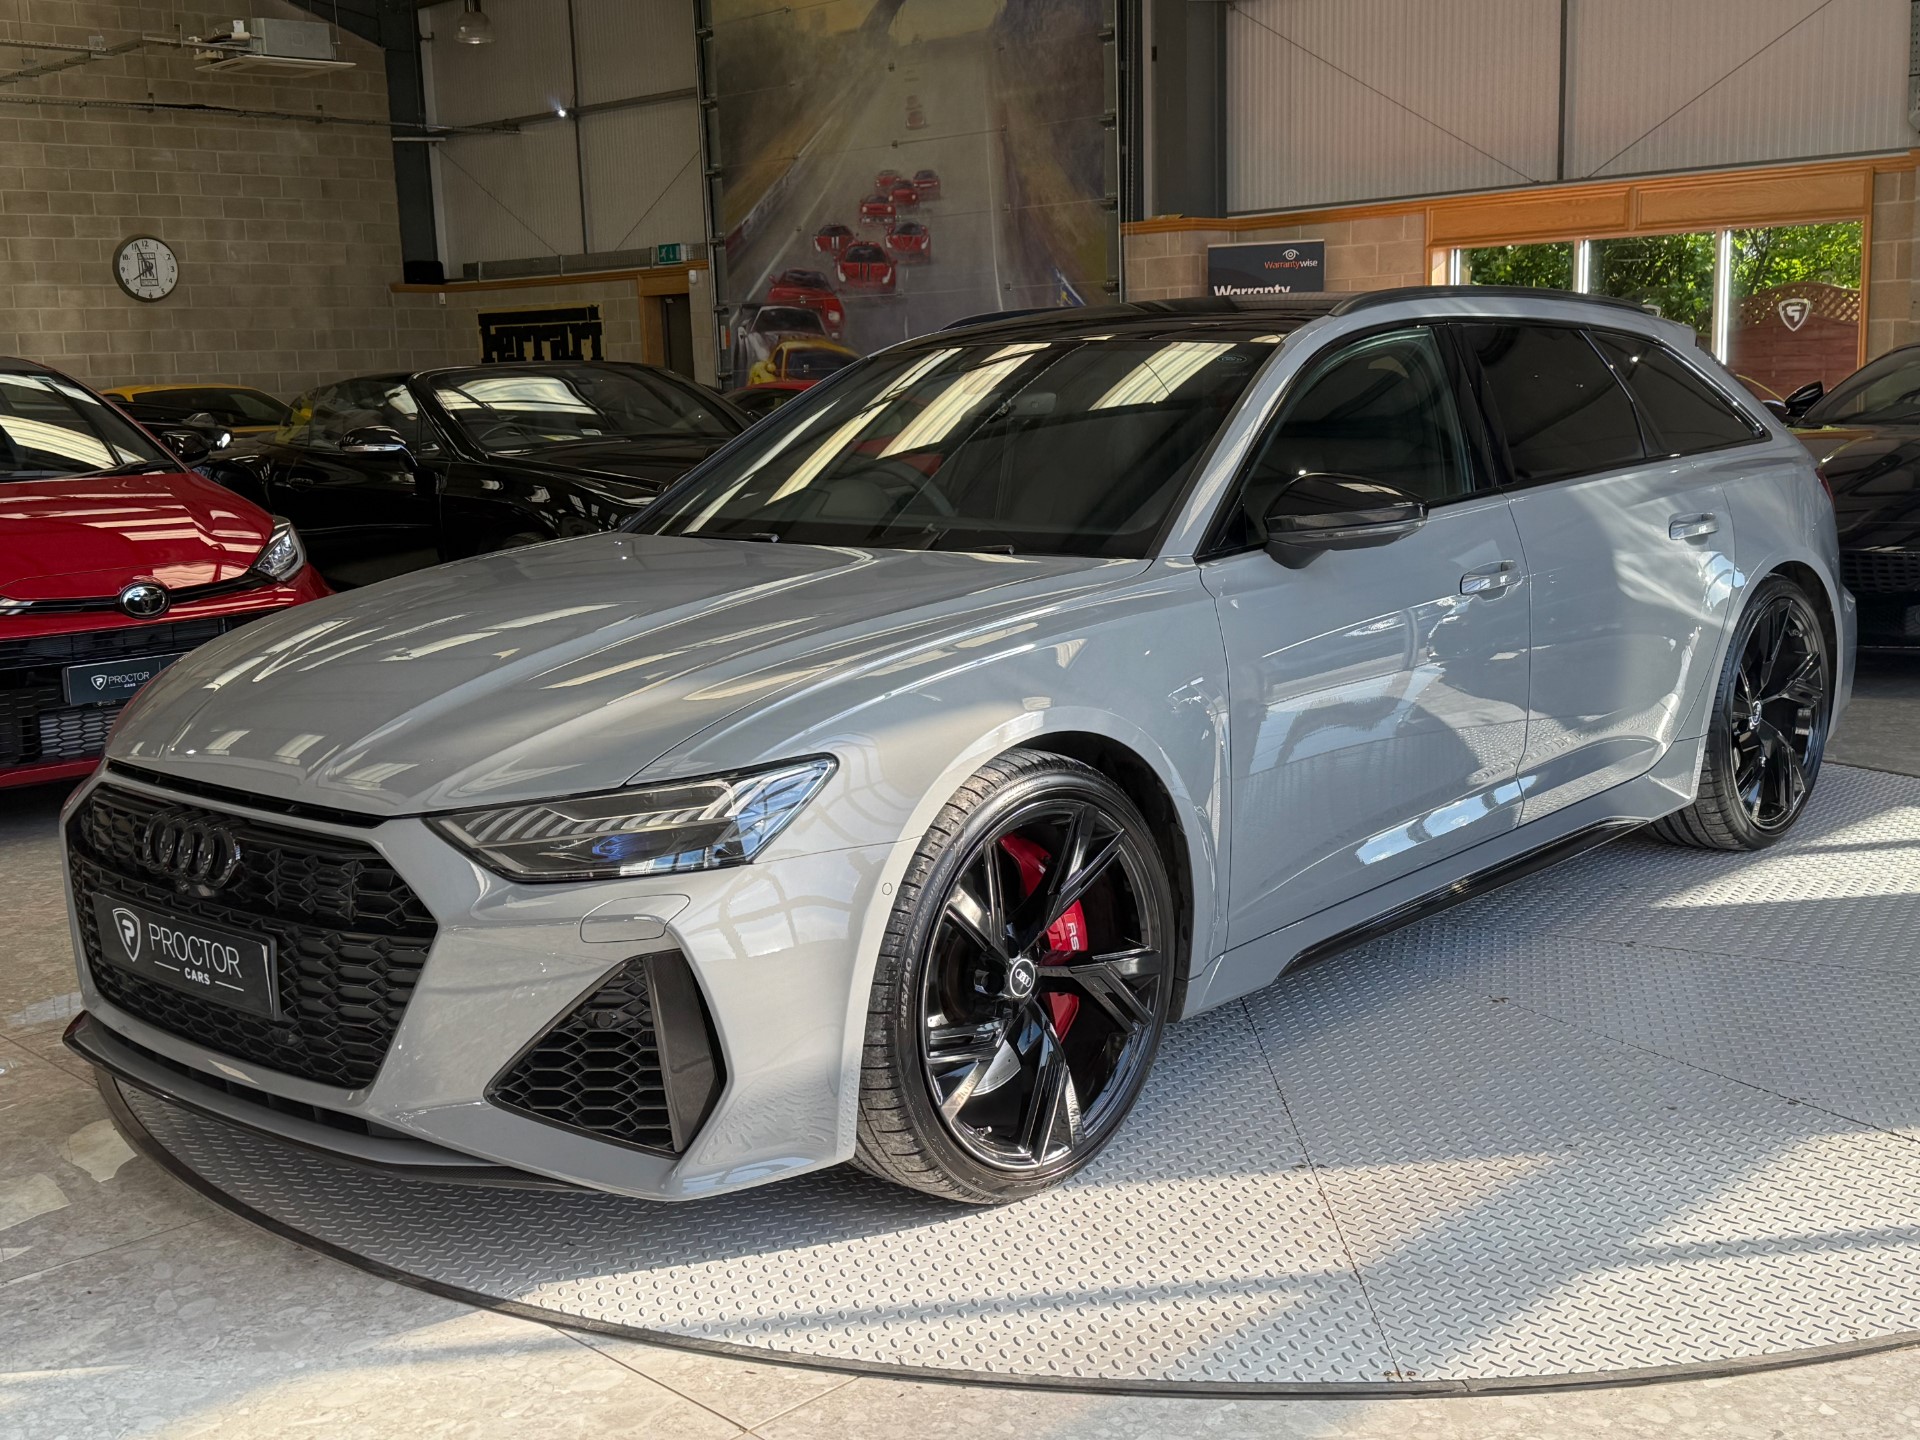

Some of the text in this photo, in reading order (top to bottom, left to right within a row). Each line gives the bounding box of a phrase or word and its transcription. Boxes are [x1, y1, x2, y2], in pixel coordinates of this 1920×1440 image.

[1264, 258, 1318, 270] Warrantywise
[478, 304, 603, 363] Ferrari
[108, 671, 150, 685] PROCTOR
[1067, 922, 1080, 951] RS
[148, 922, 242, 979] PROCTOR
[184, 967, 211, 985] CARS
